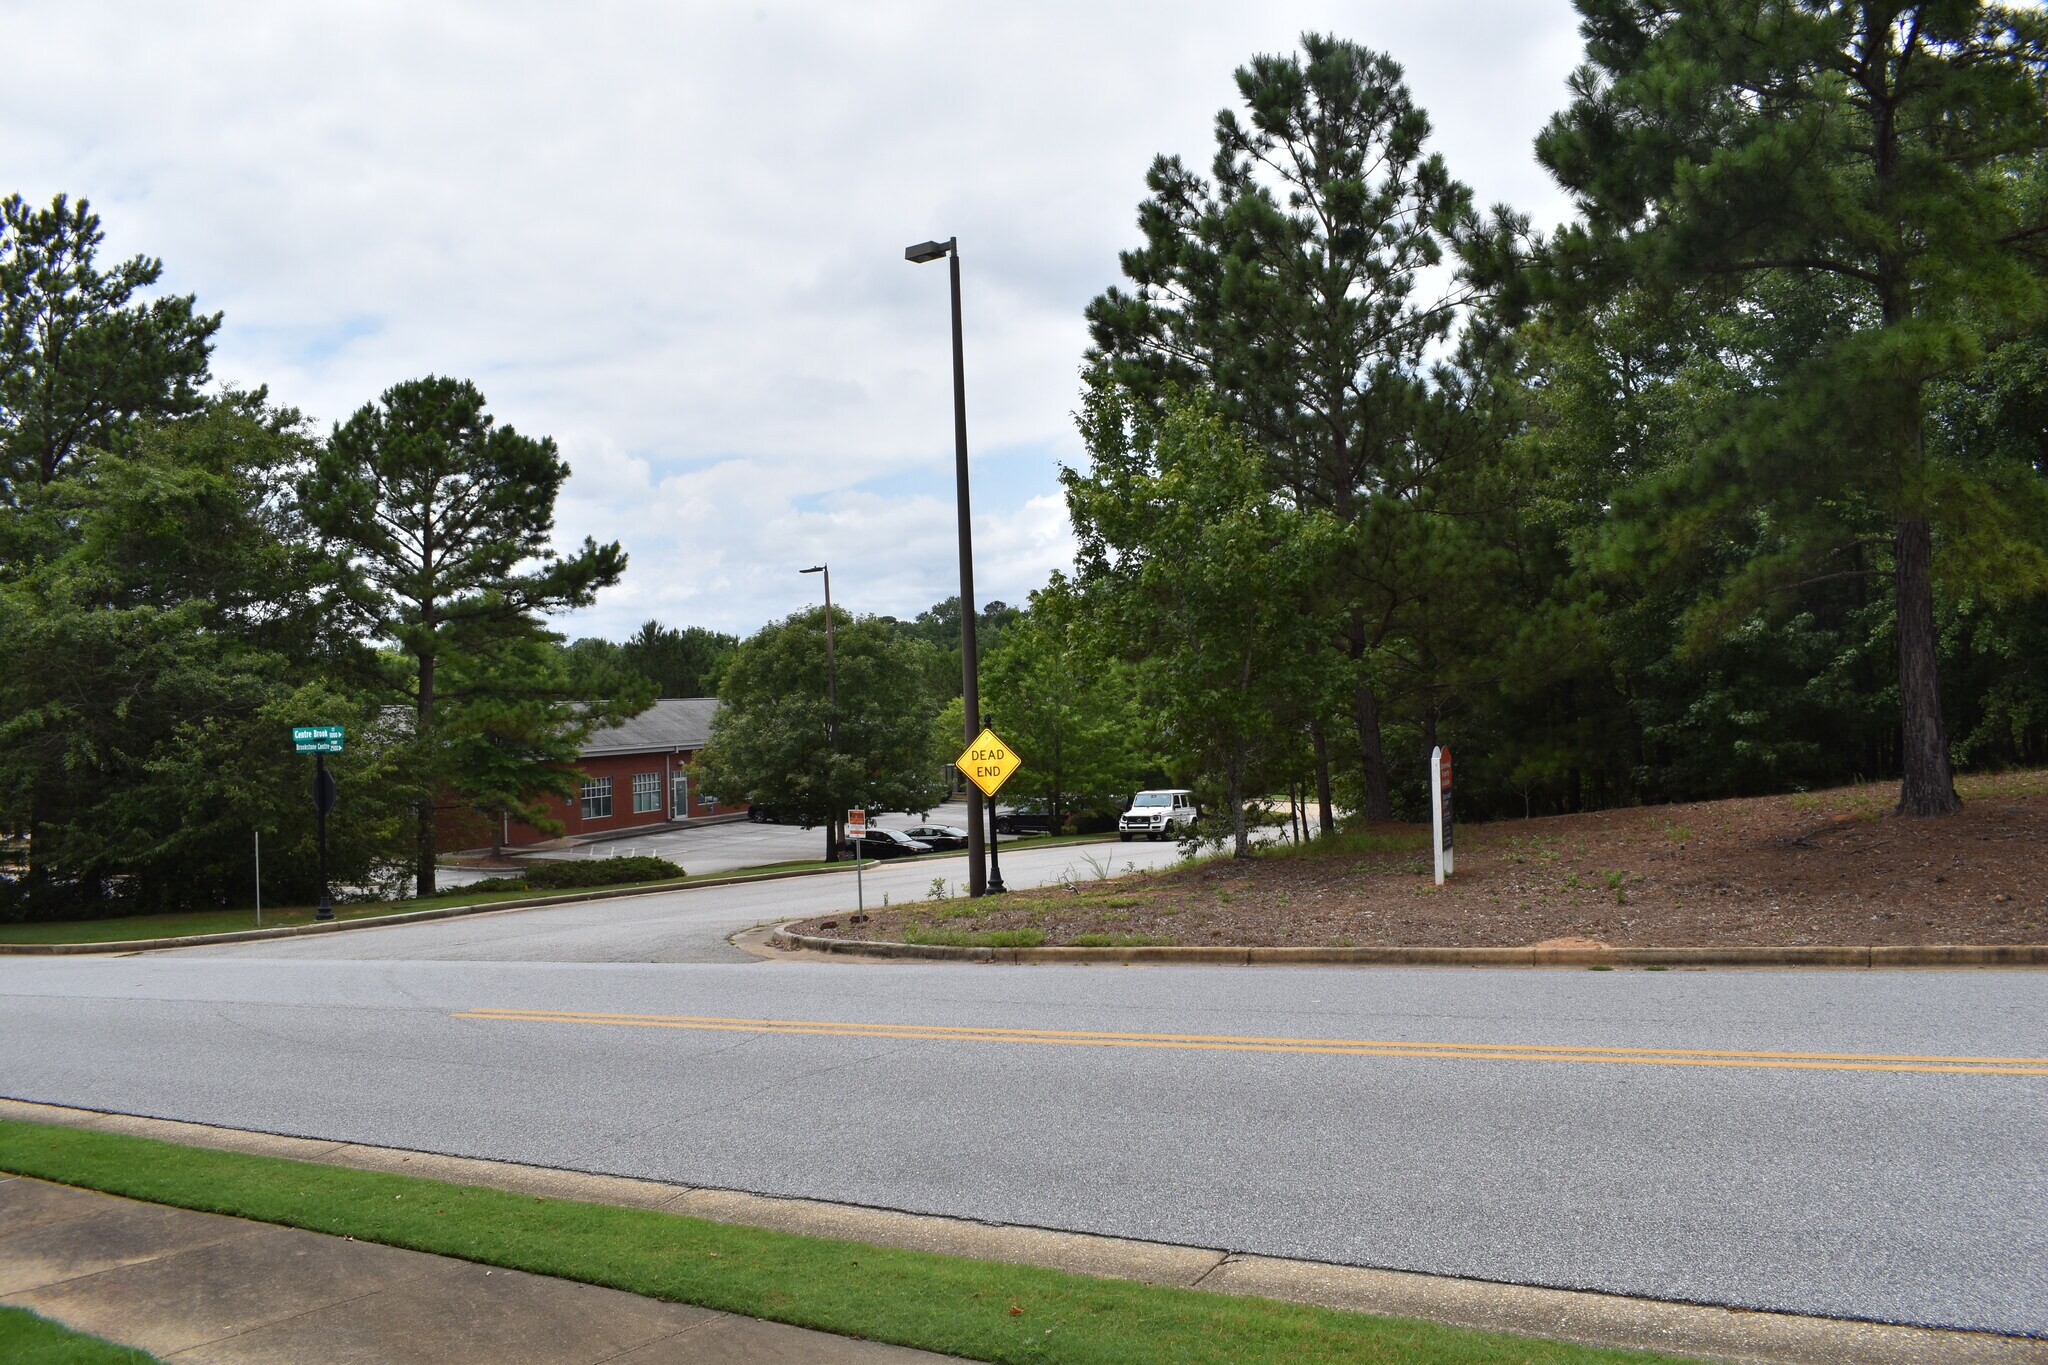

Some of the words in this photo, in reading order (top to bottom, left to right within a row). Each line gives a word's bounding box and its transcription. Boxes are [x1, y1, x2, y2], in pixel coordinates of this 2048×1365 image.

[313, 730, 328, 738] Brook
[971, 750, 1004, 760] DEAD
[977, 766, 1001, 777] END
